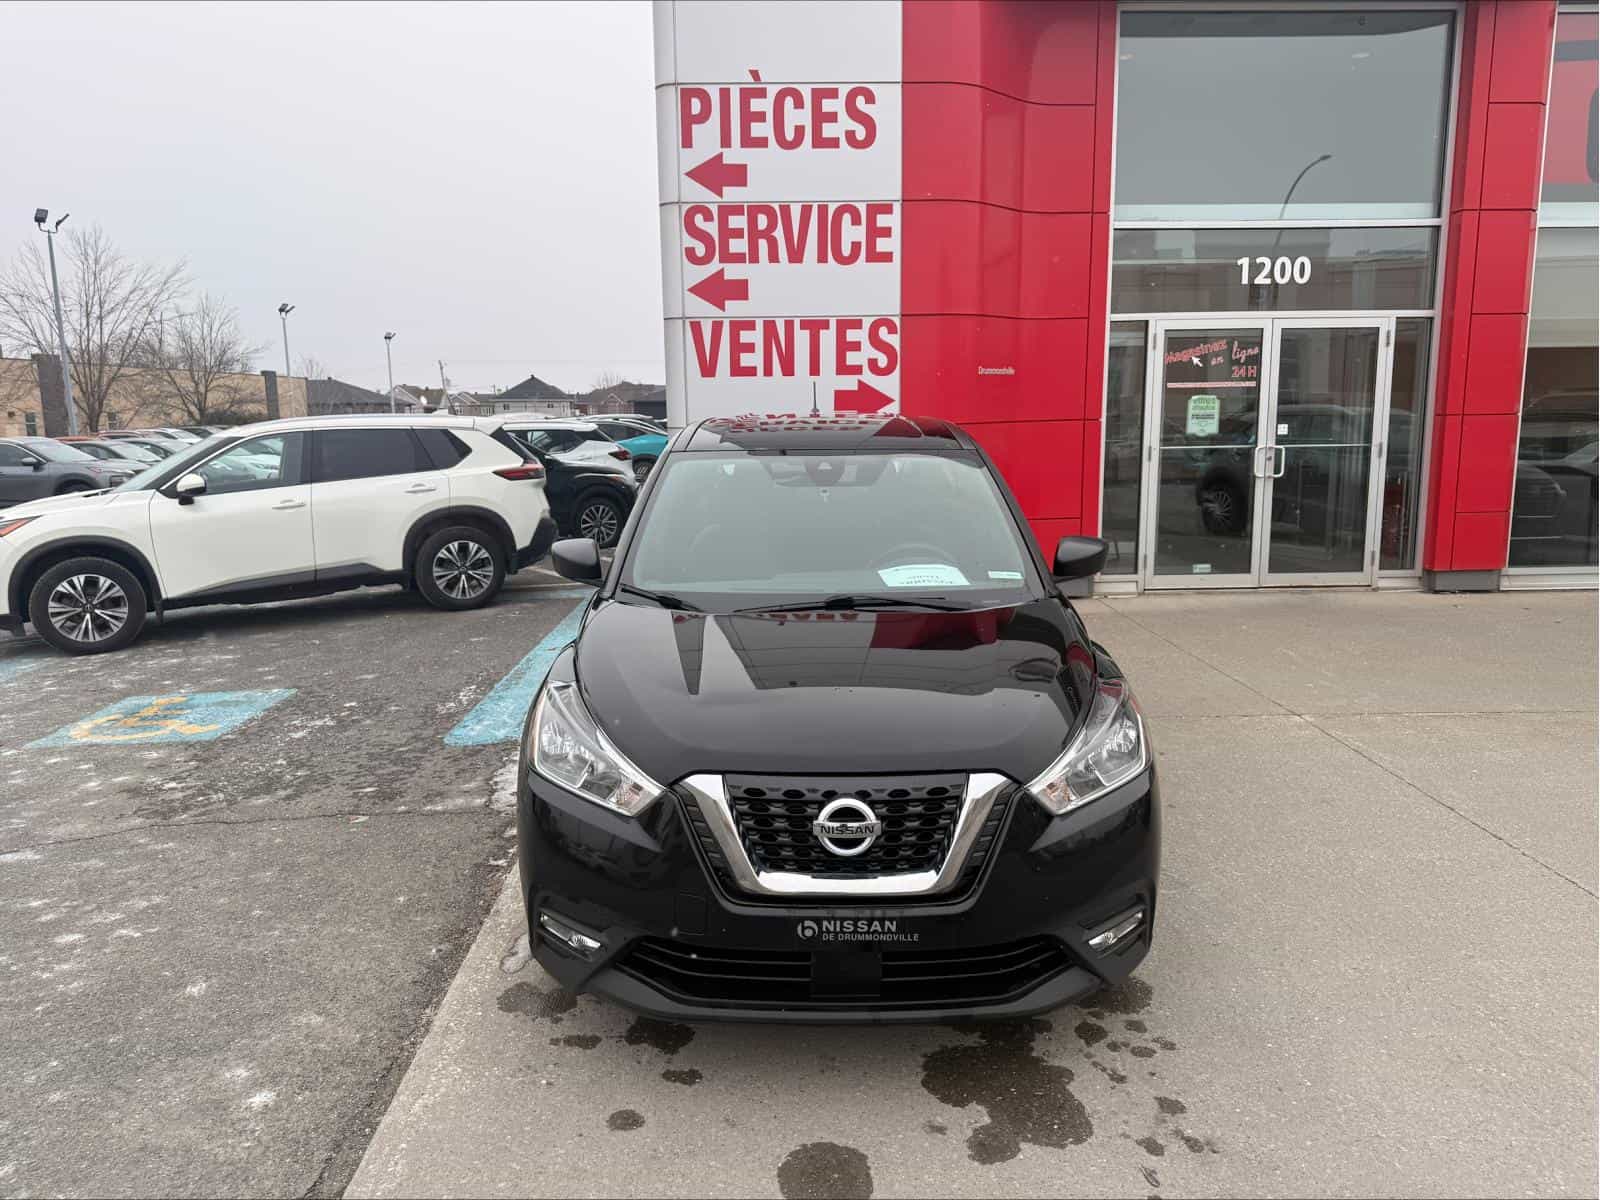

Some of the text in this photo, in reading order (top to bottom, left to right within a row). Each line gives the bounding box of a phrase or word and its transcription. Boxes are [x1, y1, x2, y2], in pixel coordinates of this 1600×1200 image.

[680, 69, 877, 150] PIÈCES
[683, 203, 894, 265] SERVICE
[1237, 256, 1312, 285] 1200
[689, 317, 899, 378] VENTES
[820, 824, 875, 835] NISSAN
[822, 920, 897, 932] NISSAN
[822, 933, 919, 941] DE DRUMMONDVILLE
